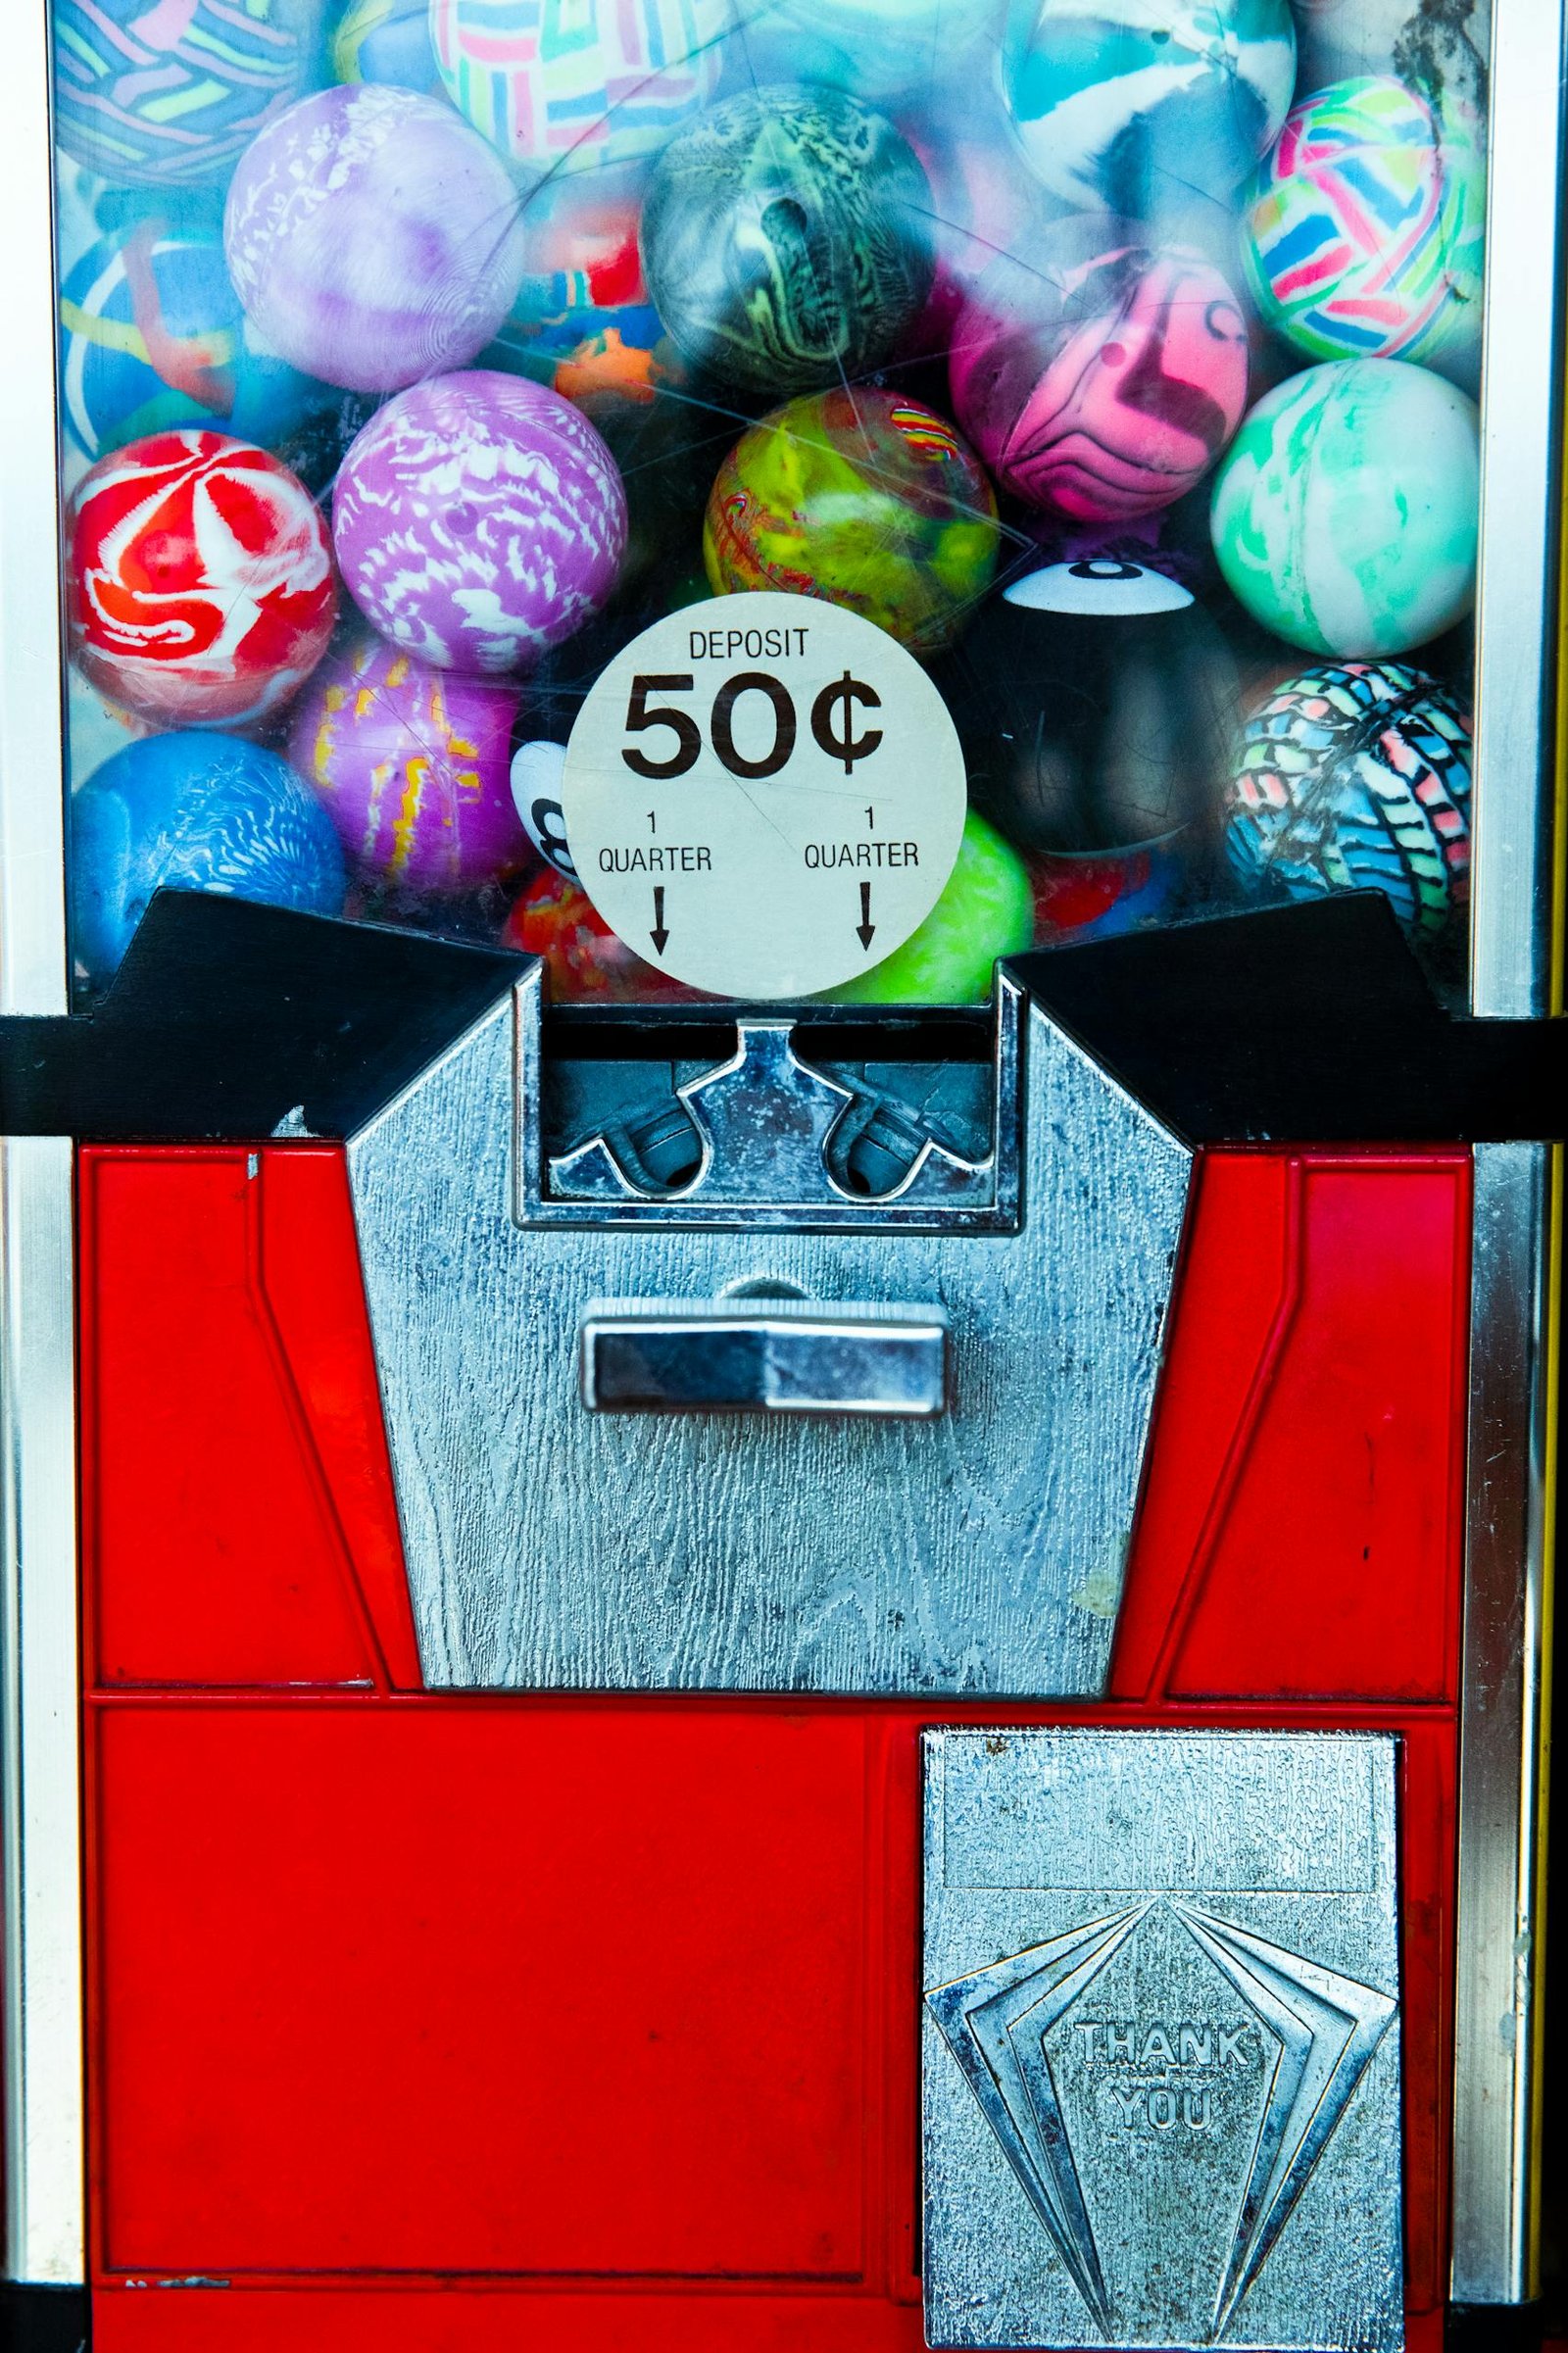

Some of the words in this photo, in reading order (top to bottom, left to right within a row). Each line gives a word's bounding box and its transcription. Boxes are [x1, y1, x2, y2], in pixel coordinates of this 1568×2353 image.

[689, 628, 809, 660] DEPOSIT
[621, 669, 884, 780] 50¢
[646, 810, 657, 834] 1
[864, 806, 874, 830] 1
[598, 847, 712, 872] QUARTER
[804, 842, 919, 869] QUARTER
[1073, 2021, 1250, 2067] THANK
[1110, 2085, 1212, 2132] YOU
